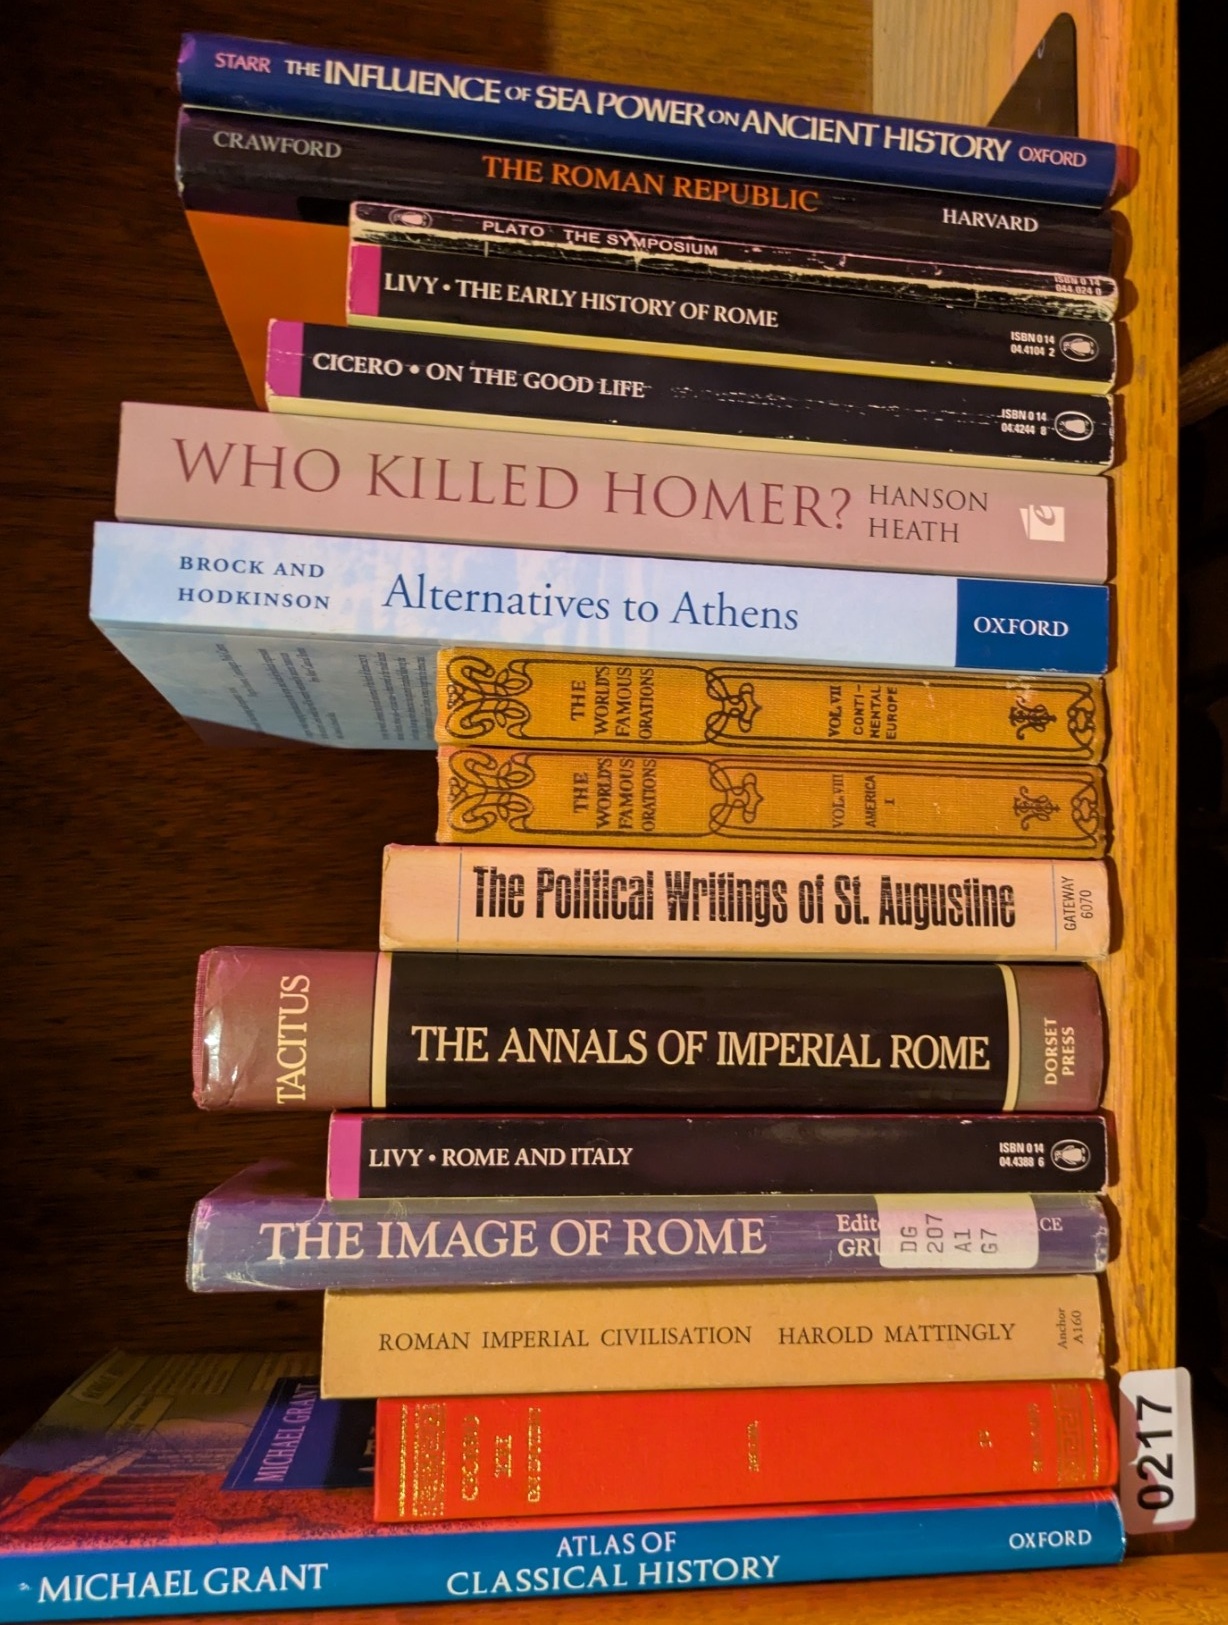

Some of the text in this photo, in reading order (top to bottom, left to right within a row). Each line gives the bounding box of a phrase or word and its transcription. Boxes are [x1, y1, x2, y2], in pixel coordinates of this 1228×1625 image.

[214, 52, 271, 74] STARR
[284, 59, 1012, 163] THE INFLUENCE OF SEA POWER ON ANCIENT HISTORY
[213, 130, 342, 159] CRAWFORD
[1018, 145, 1087, 168] OXFORD
[482, 155, 818, 212] THE ROMAN REPUBLIC
[483, 220, 544, 238] PLATO
[942, 208, 1039, 233] HARVARD
[563, 228, 718, 256] THE SYMPOSIUM
[384, 272, 439, 296] LIVY
[455, 279, 779, 328] THE EARLY HISTORY OF ROME
[1010, 331, 1035, 342] ISBN
[312, 352, 402, 377] CICERO
[426, 362, 646, 399] ON THE GOOD LIFE
[1001, 409, 1026, 420] ISBN
[172, 438, 851, 530] WHO KILLED HOMER?
[869, 484, 989, 512] HANSON
[869, 518, 959, 544] HEATH
[179, 556, 325, 578] BROCK AND
[178, 587, 330, 610] HODKINSON
[382, 573, 798, 631] Alternatives to Athens
[973, 616, 1069, 638] OXFORD
[570, 679, 587, 721] THE
[615, 667, 632, 738] FAMOUS
[639, 666, 655, 740] ORATIONS
[829, 685, 841, 704] VII
[854, 685, 864, 735] CONTI-
[871, 685, 882, 738] MENTAL
[886, 686, 898, 740] EUROPE
[573, 772, 589, 813] THE
[619, 758, 635, 830] FAMOUS
[642, 759, 657, 831] ORATIONS
[833, 774, 844, 794] VIII
[866, 775, 877, 828] AMERICA
[473, 866, 1015, 931] The Political Writings of St. Augustine
[1063, 876, 1077, 931] GATEWAY
[1080, 890, 1092, 919] 6070
[277, 974, 310, 1106] TACITUS
[411, 1025, 990, 1071] THE ANNALS OF IMPERIAL ROME
[1044, 1017, 1057, 1085] DORSET
[1062, 1026, 1075, 1077] PRESS
[369, 1149, 424, 1168] LIVY
[441, 1148, 633, 1167] ROME AND ITALY
[999, 1142, 1025, 1153] ISBN
[259, 1217, 767, 1261] THE IMAGE OF ROME
[900, 1226, 918, 1253] DG
[926, 1214, 944, 1253] 207
[953, 1228, 971, 1253] A1
[980, 1229, 997, 1253] G7
[379, 1326, 751, 1352] ROMAN IMPERIAL CIVILISATION
[778, 1322, 1016, 1346] HAROLD MATTINGLY
[1057, 1307, 1067, 1350] Anchor
[1073, 1310, 1083, 1344] A160
[254, 1383, 320, 1481] MICHAEL GRANT
[1136, 1394, 1174, 1510] 0217
[556, 1531, 676, 1557] ATLAS OF
[1009, 1530, 1092, 1550] OXFORD
[38, 1563, 329, 1604] MICHAEL GRANT
[446, 1554, 780, 1595] CLASSICAL HISTORY
